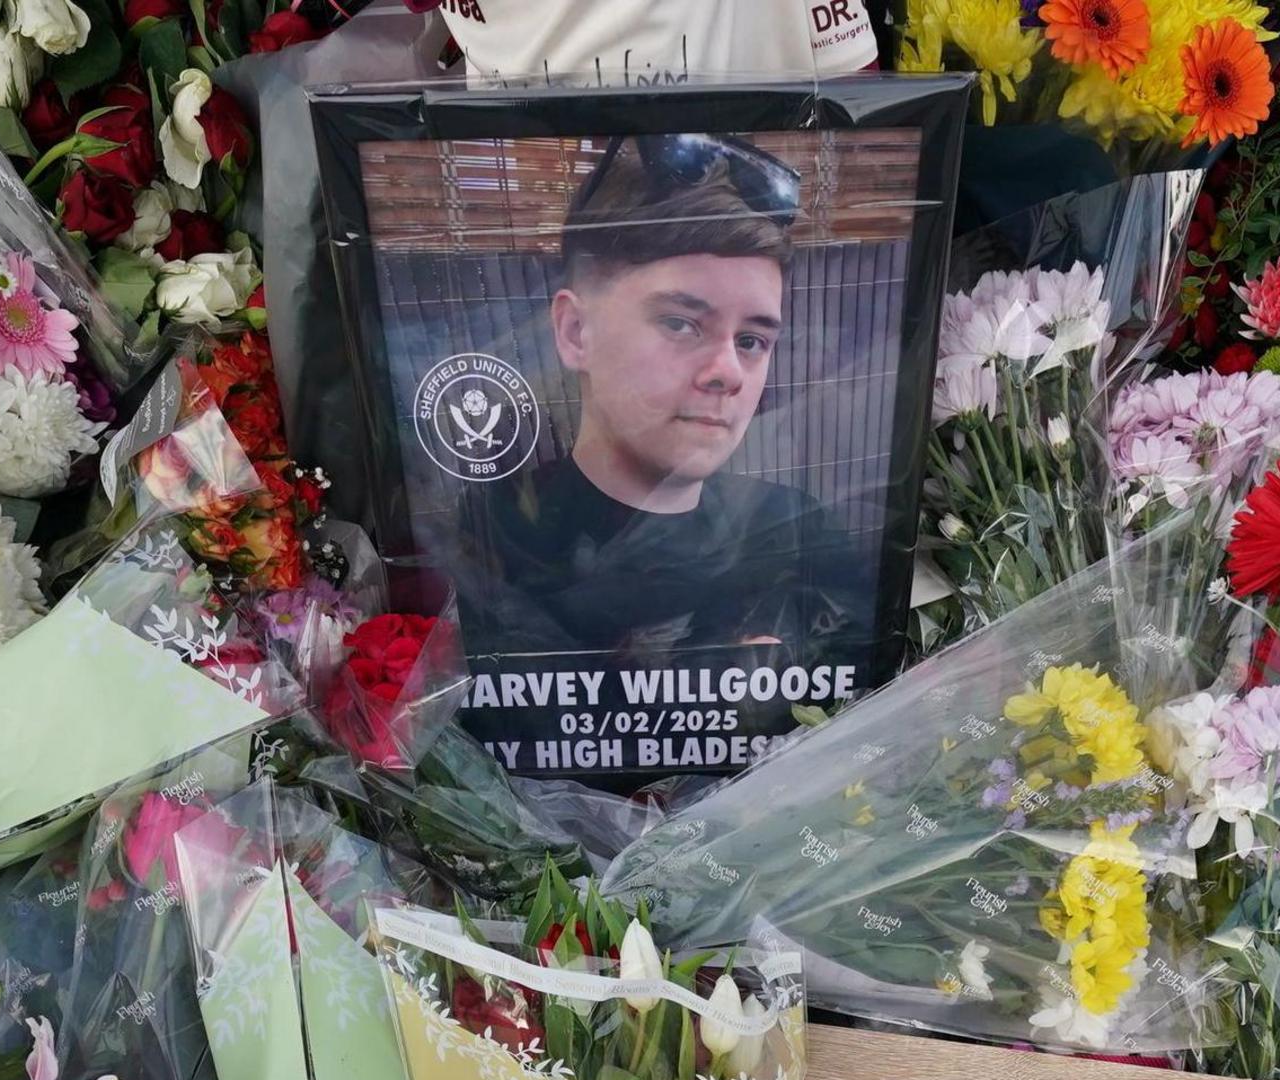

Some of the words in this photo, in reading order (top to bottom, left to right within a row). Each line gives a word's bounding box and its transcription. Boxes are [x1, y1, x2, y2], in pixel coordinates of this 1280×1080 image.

[835, 22, 869, 43] Surgery
[420, 359, 468, 420] SHEFFIELD
[473, 359, 520, 390] UNITED
[469, 462, 497, 474] 1889
[620, 665, 855, 704] WILLGOOSE
[560, 709, 739, 737] 03/02/2025
[536, 739, 623, 769] HIGH
[638, 735, 780, 767] BLADES
[160, 769, 205, 802] Flourish
[799, 825, 840, 862] Flourish
[134, 880, 179, 911] Flourish
[966, 877, 1009, 913] Flourish
[857, 906, 903, 930] Flourish
